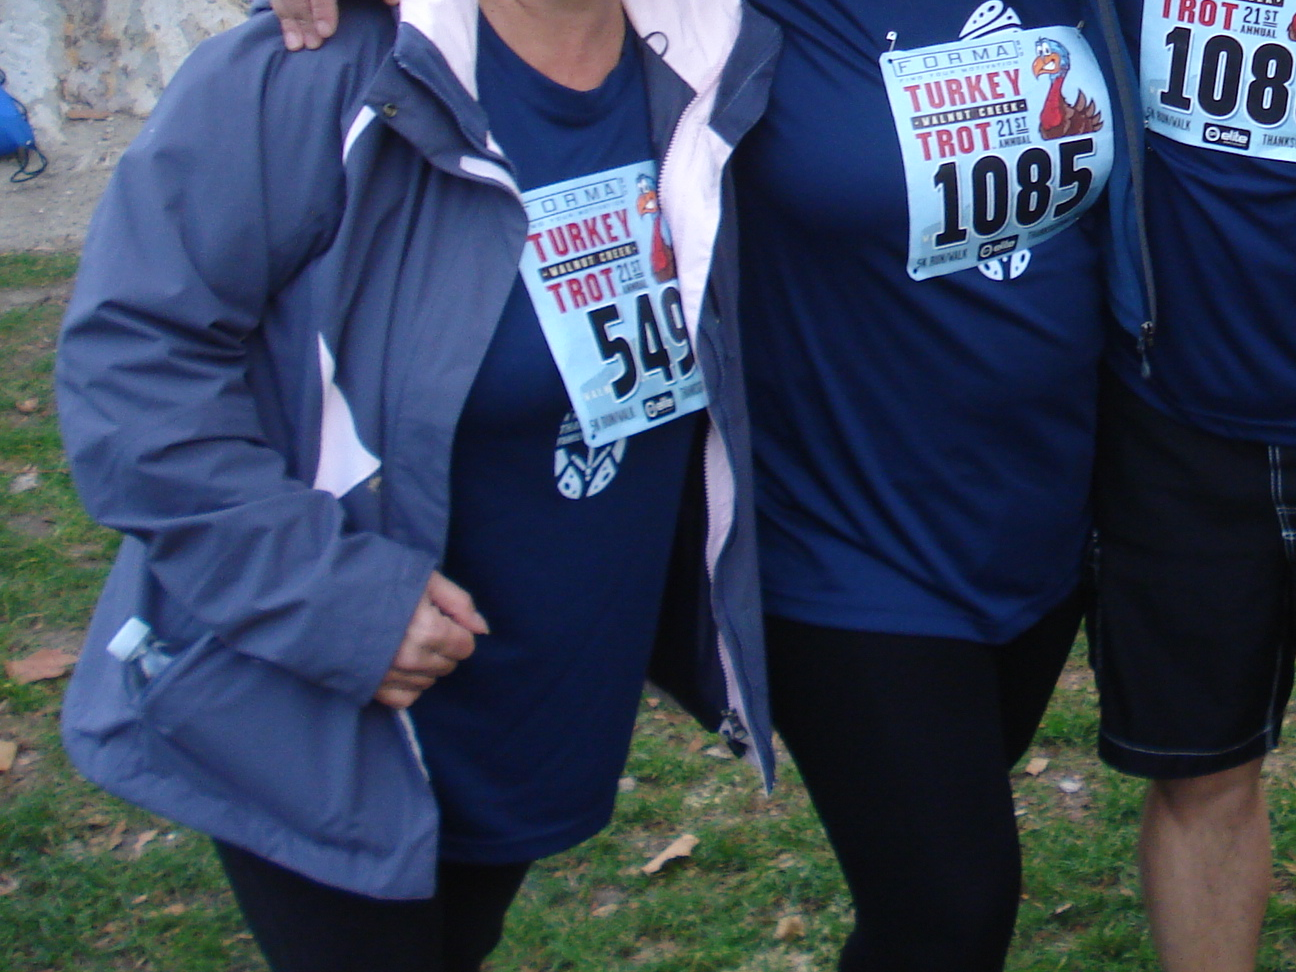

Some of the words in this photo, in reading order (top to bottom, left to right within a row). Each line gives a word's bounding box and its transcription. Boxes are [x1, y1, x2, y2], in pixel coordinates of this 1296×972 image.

[1242, 6, 1279, 28] 21ST
[1240, 24, 1278, 39] ANNUAL
[898, 44, 1009, 74] FORMA
[903, 69, 1021, 113] TURKEY
[921, 111, 971, 127] WALNUT
[978, 102, 1018, 117] CREEK
[915, 122, 991, 161] TROT
[996, 116, 1029, 138] 21ST
[999, 135, 1032, 149] ANNUAL
[1220, 129, 1249, 144] elite
[524, 183, 616, 214] ORMA
[933, 137, 1094, 248] 1085
[525, 208, 632, 264] TURKEY
[993, 239, 1016, 252] elite
[599, 245, 632, 263] CREEK
[545, 267, 617, 315] TROT
